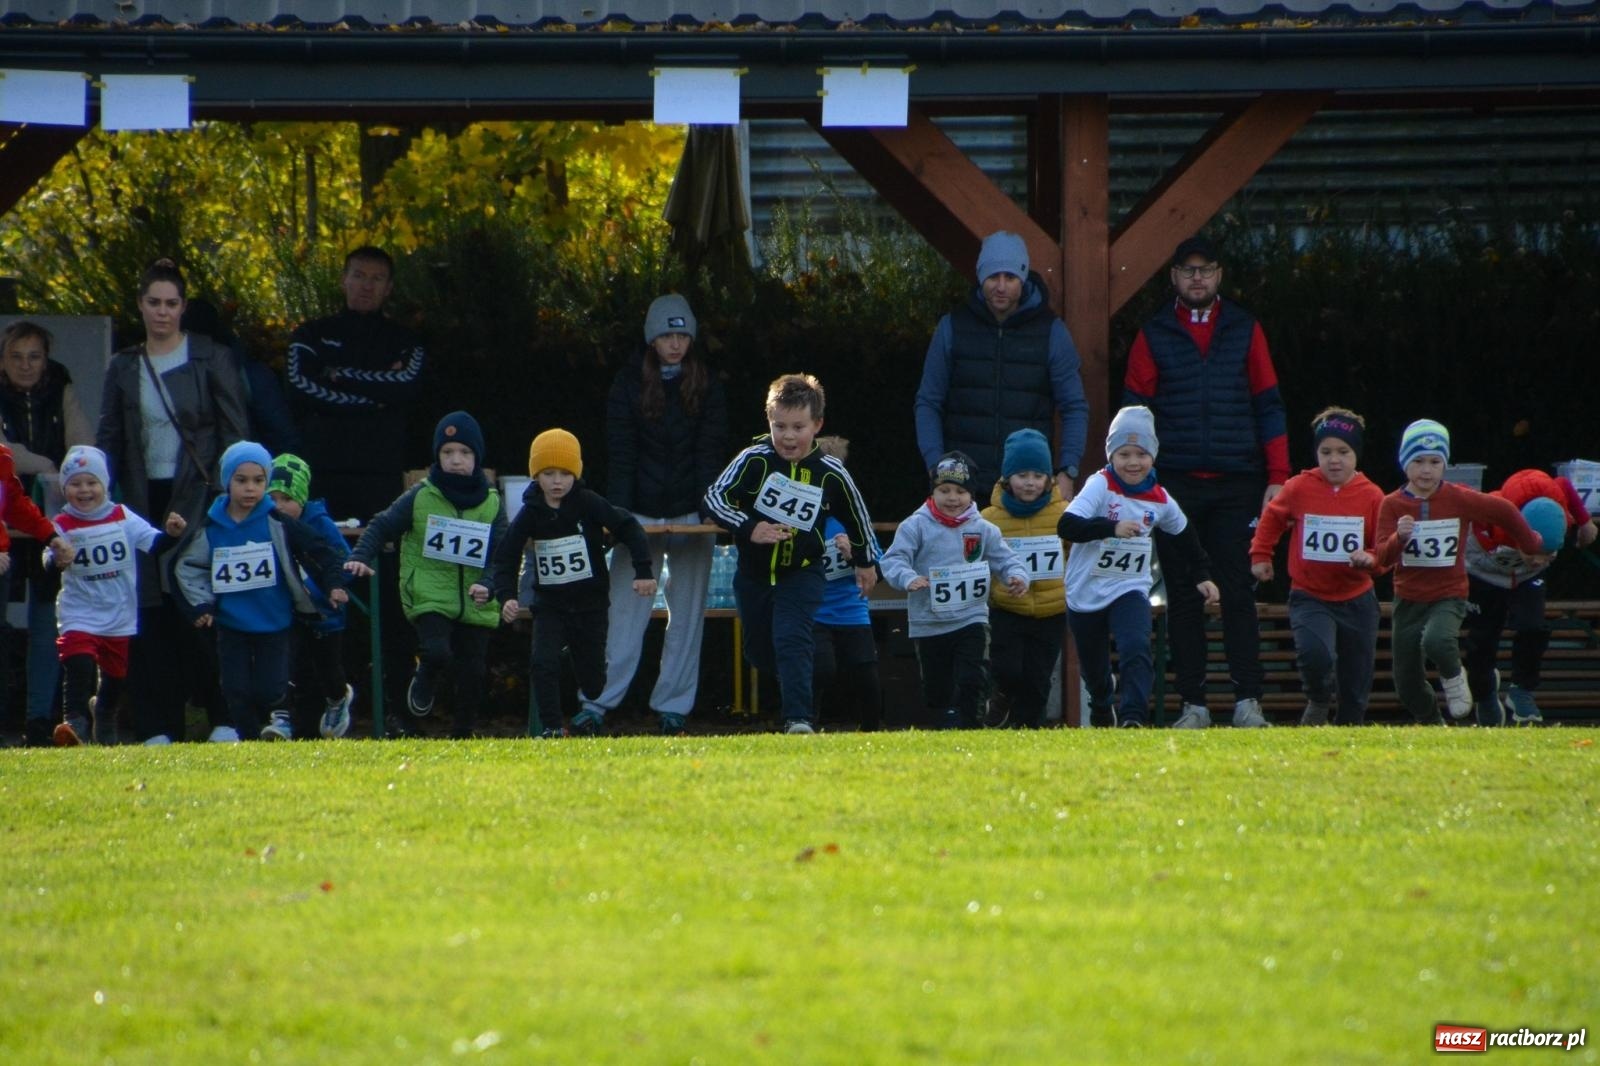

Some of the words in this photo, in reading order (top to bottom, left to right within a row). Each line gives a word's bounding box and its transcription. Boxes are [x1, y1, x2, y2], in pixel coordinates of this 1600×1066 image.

[761, 487, 816, 521] 545
[74, 540, 127, 567] 409
[427, 532, 484, 558] 412
[1305, 531, 1359, 554] 406
[1404, 536, 1458, 558] 432
[215, 559, 272, 584] 434
[538, 551, 586, 577] 555
[1097, 550, 1146, 573] 541
[935, 578, 987, 603] 515
